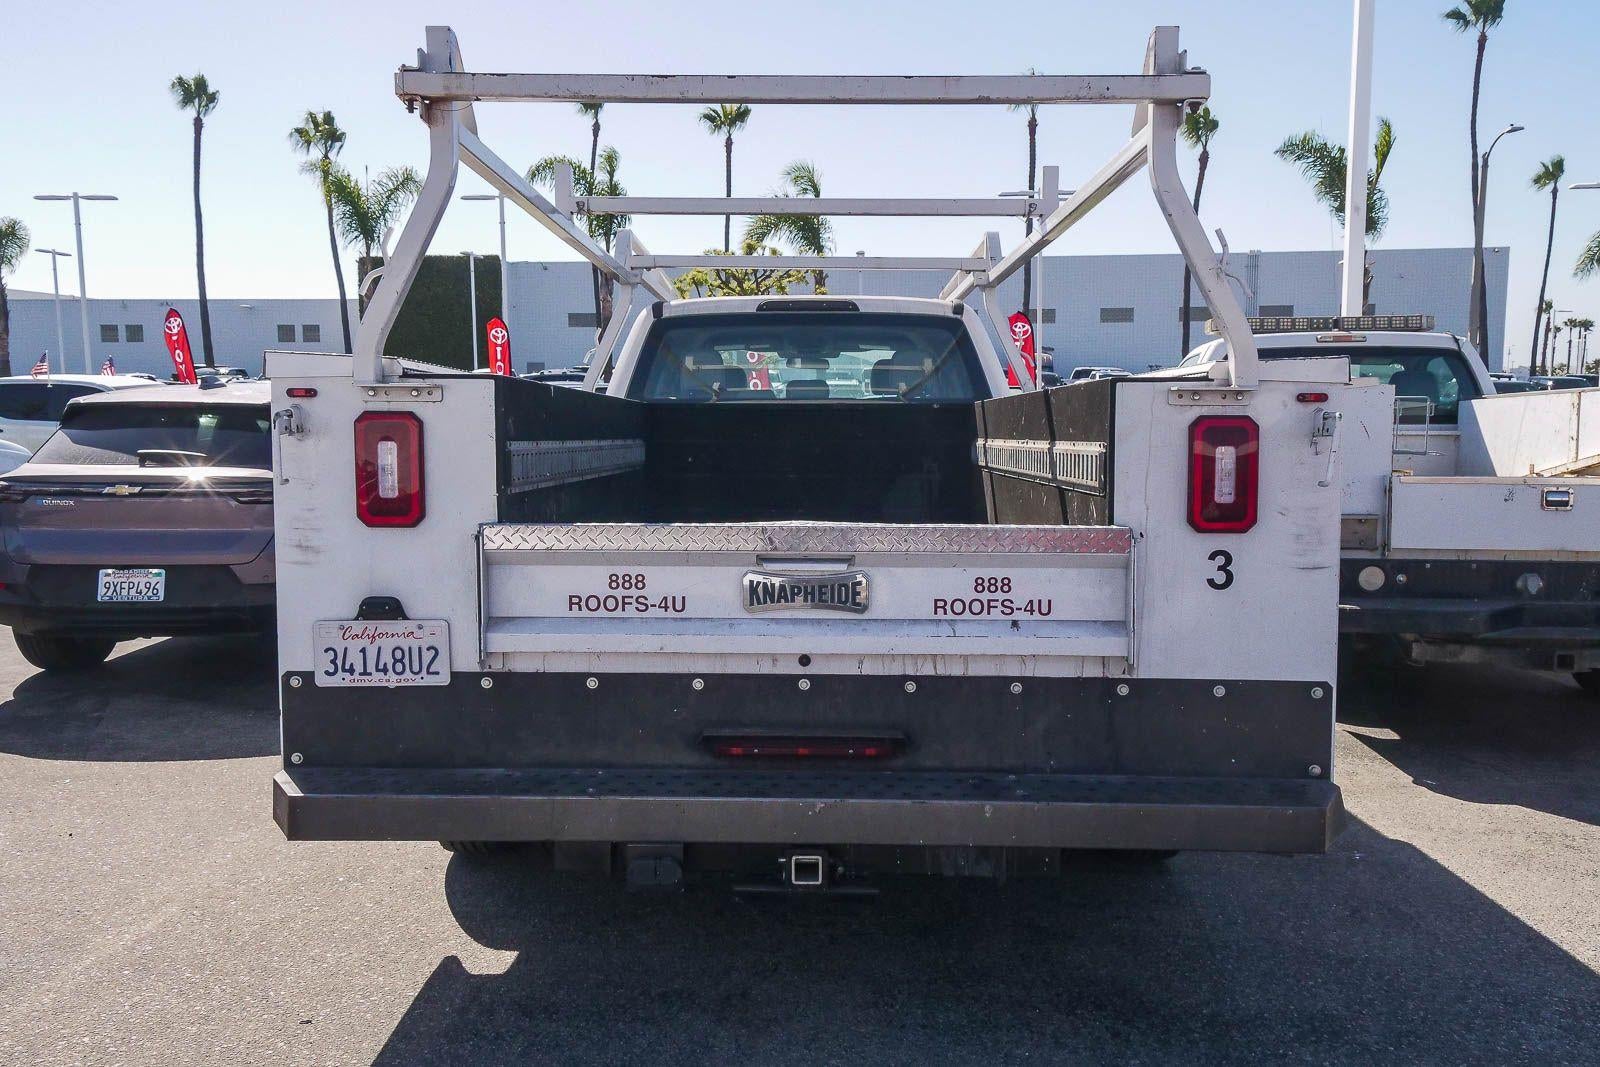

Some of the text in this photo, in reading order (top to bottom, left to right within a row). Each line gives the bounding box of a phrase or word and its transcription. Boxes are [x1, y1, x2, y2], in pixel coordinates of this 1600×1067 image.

[1206, 549, 1235, 591] 3
[103, 581, 160, 596] 9XFP496
[608, 573, 647, 591] 888
[973, 576, 1012, 594] 888
[749, 579, 863, 608] KNAPHEIDE
[568, 594, 687, 613] ROOFS-4U
[933, 597, 1052, 616] ROOFS-4U
[341, 625, 423, 645] California
[323, 645, 440, 677] 34148U2
